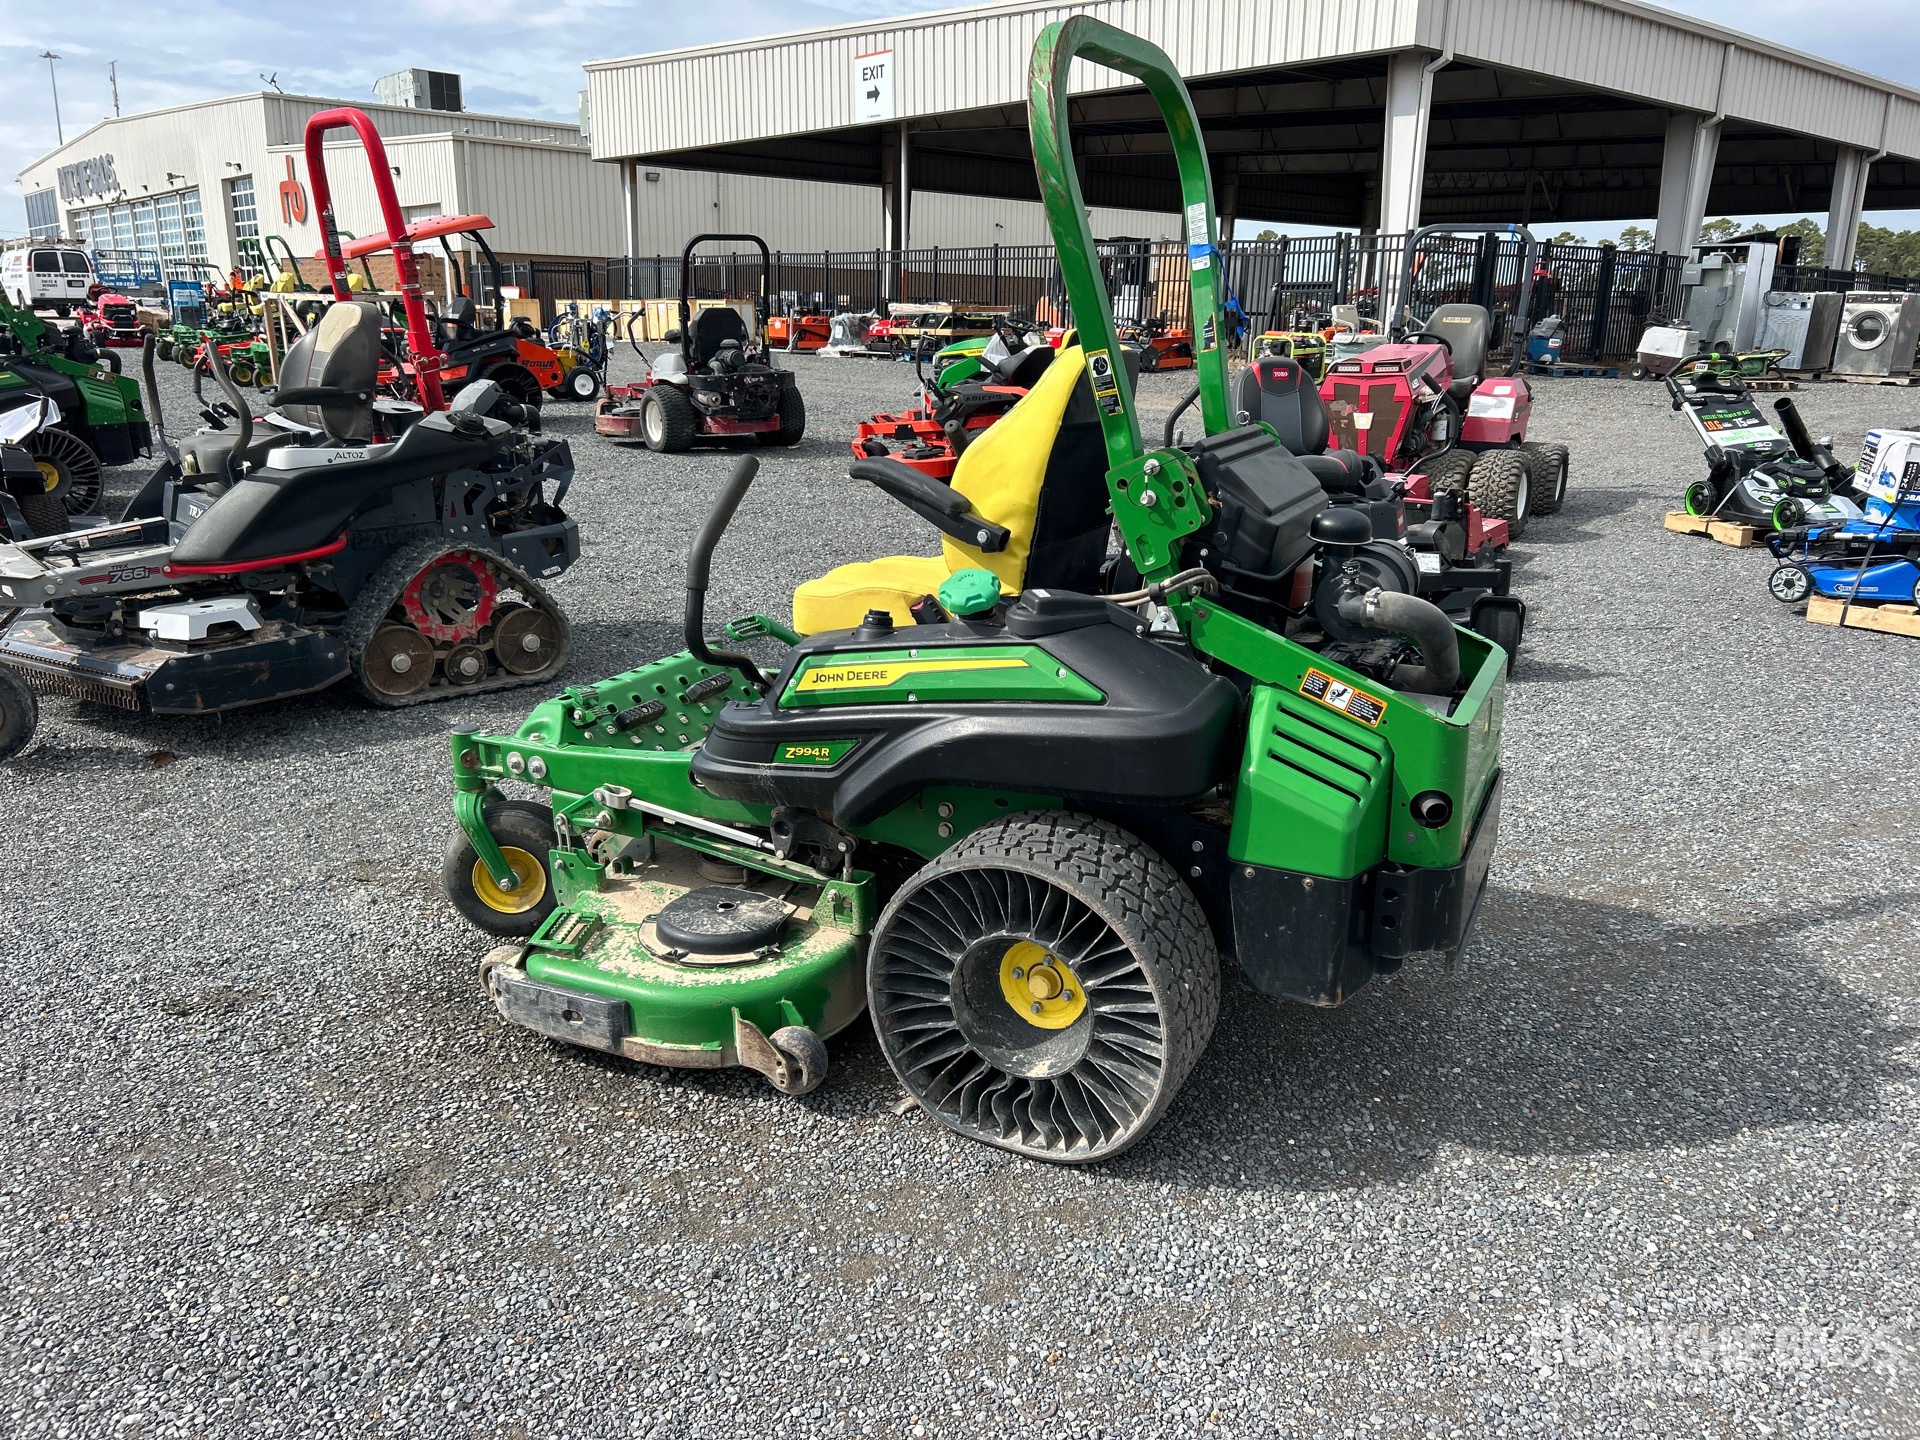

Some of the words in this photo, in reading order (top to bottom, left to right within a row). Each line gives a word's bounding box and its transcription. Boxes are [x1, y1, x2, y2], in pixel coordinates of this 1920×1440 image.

[862, 64, 885, 81] EXIT
[333, 451, 365, 460] ALTOZ
[189, 505, 204, 519] TRX
[109, 567, 150, 584] 766i
[812, 672, 844, 684] JOHN
[846, 670, 888, 681] DEERE
